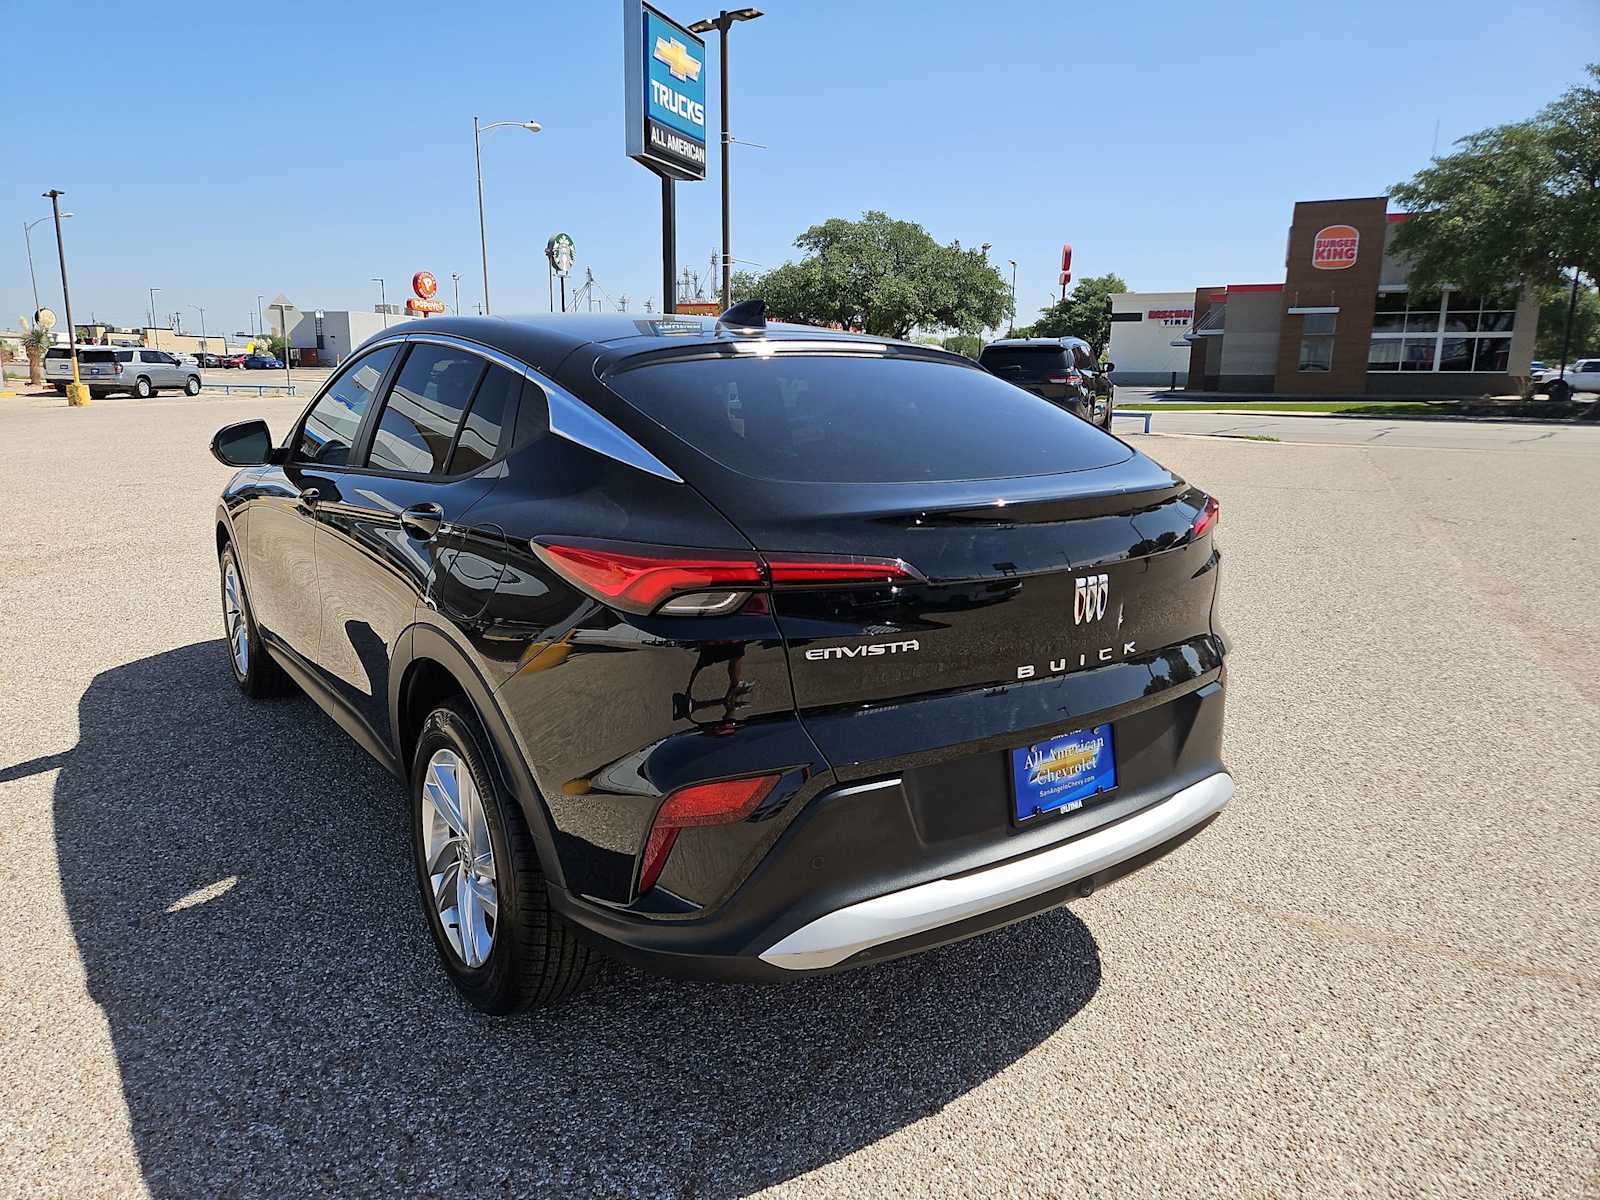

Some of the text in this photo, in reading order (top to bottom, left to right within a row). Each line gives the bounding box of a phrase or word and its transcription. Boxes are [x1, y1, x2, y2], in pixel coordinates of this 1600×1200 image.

[651, 79, 704, 126] TRUCKS
[651, 126, 705, 164] ALL AMERICAN
[1315, 239, 1356, 260] BURGER KING
[805, 639, 920, 660] ENVISTA
[1017, 641, 1136, 679] BUICK
[1024, 736, 1104, 770] All American
[1037, 756, 1097, 785] Chevrolet
